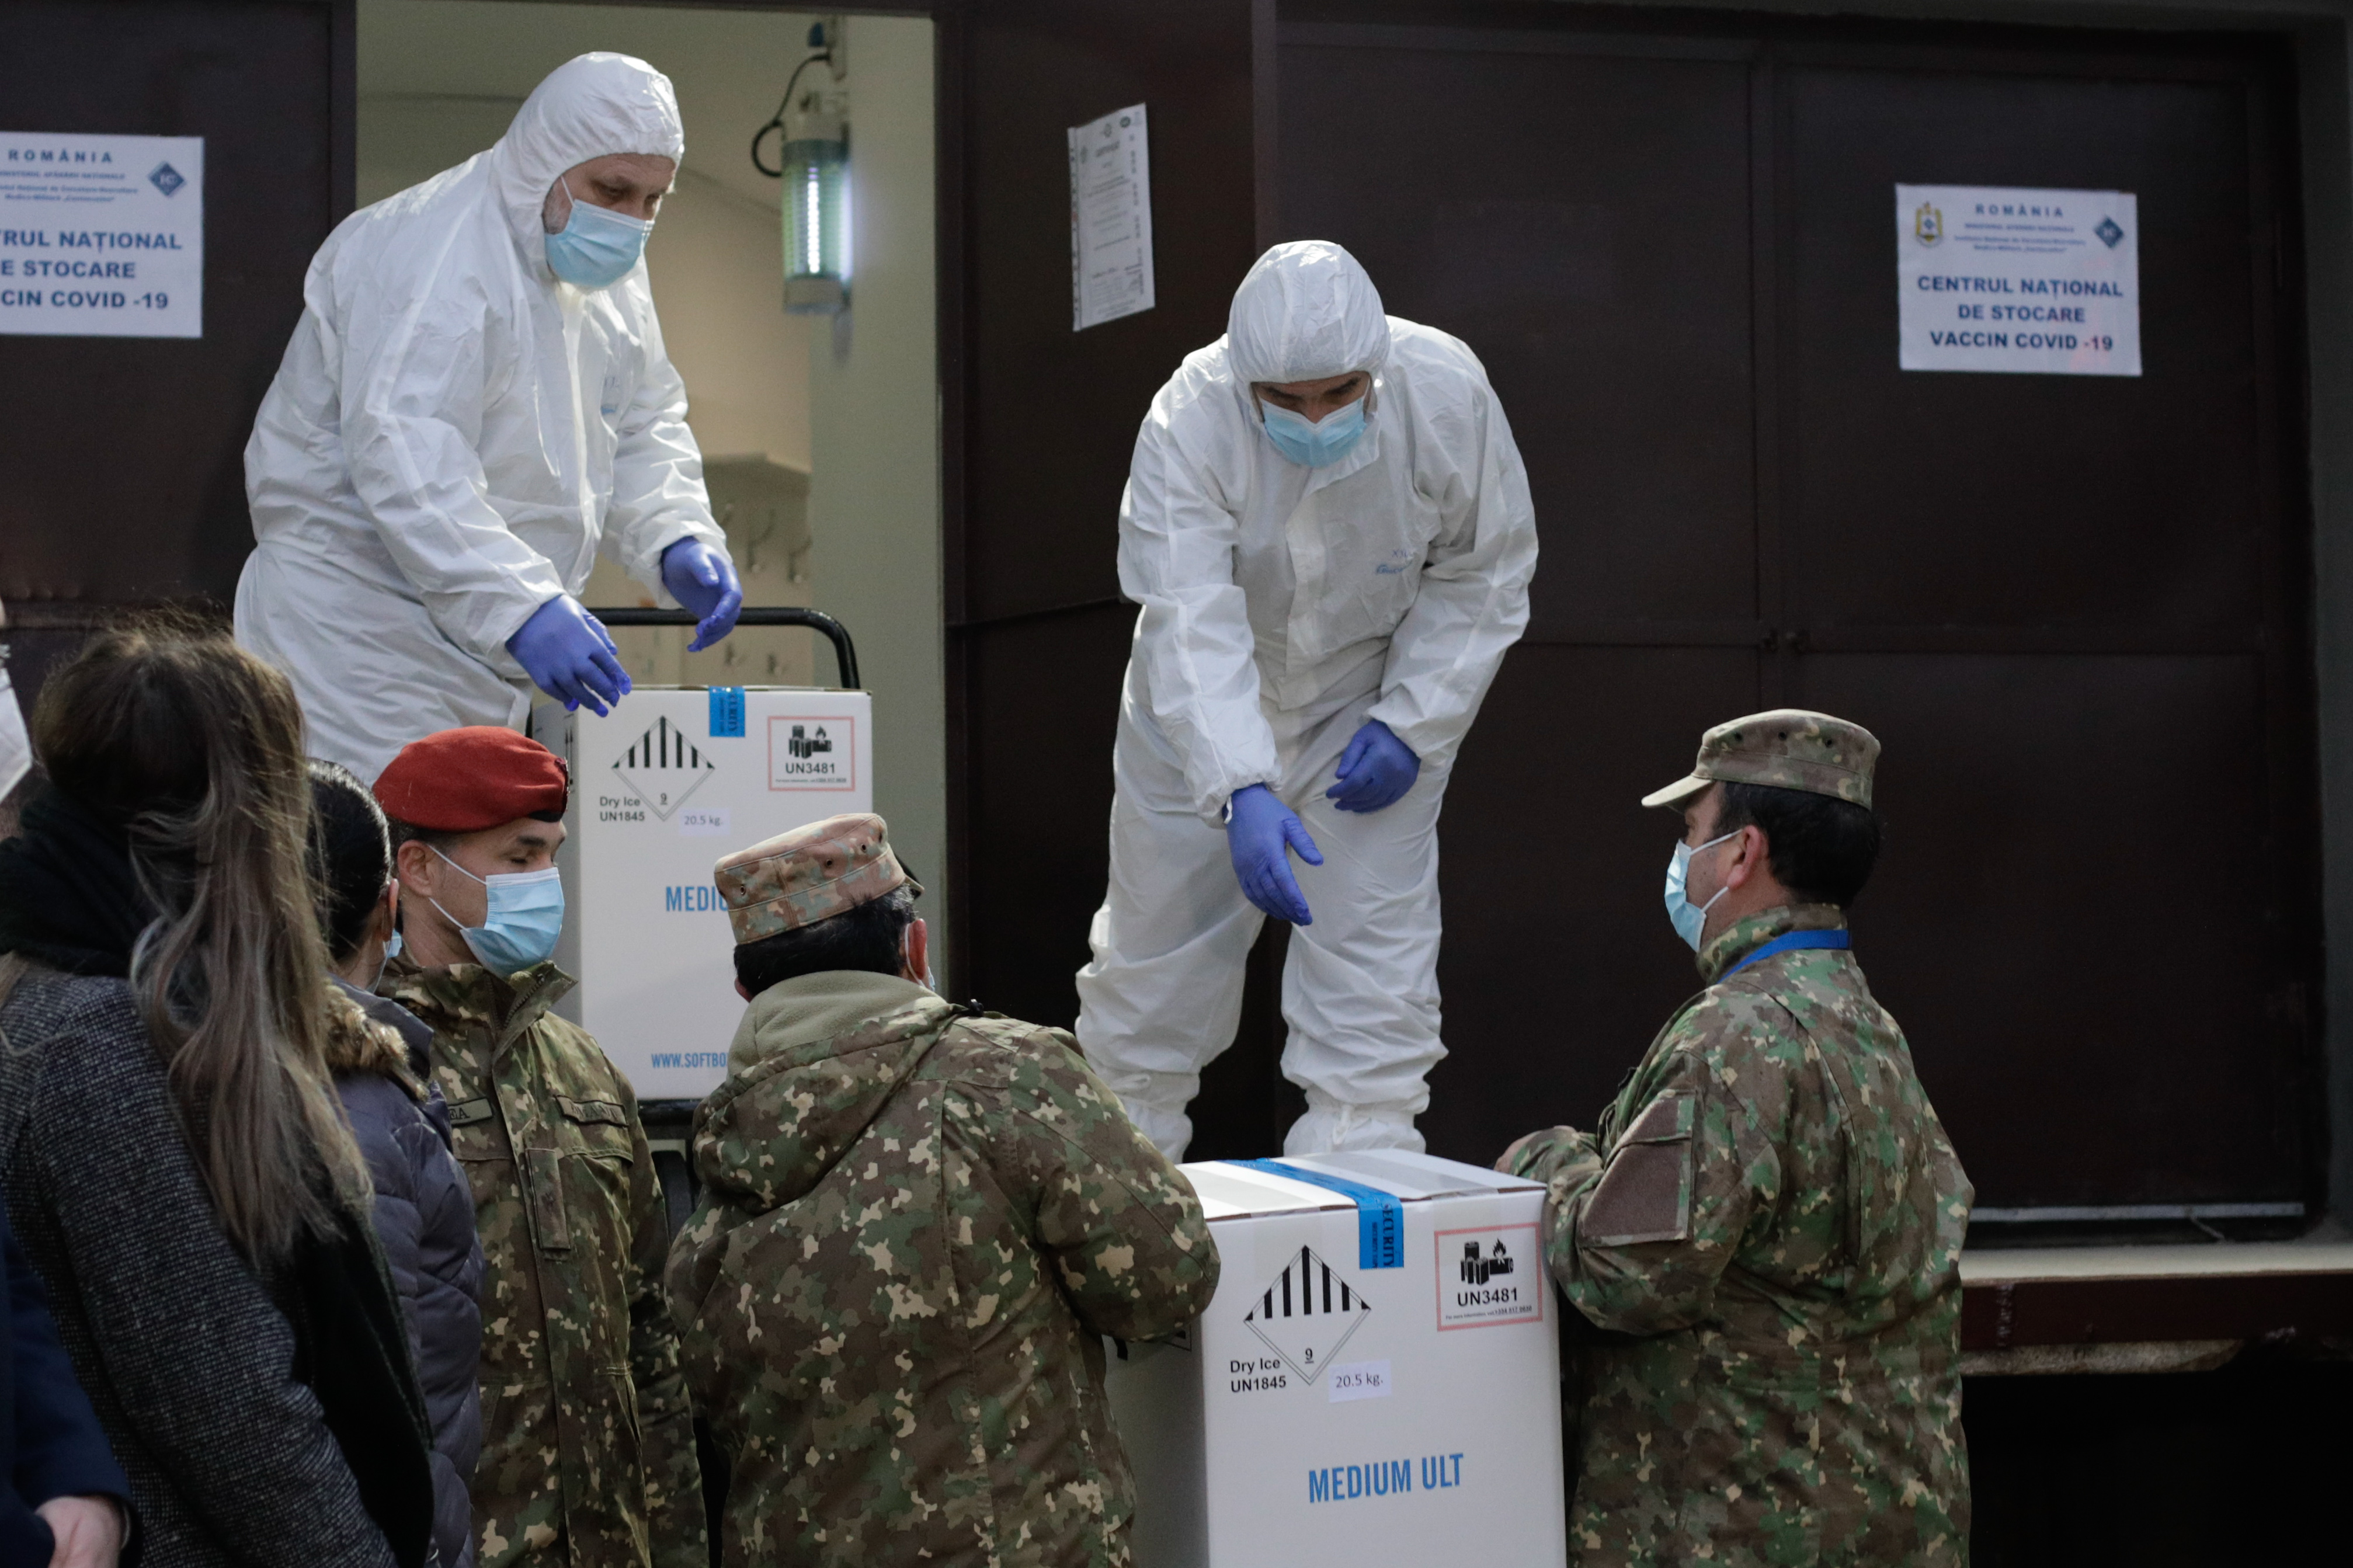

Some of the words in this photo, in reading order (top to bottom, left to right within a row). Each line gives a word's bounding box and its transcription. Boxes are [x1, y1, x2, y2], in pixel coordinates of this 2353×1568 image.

[0, 230, 50, 247] RUL
[59, 231, 182, 253] NAȚIONAL
[23, 260, 136, 279] STOCARE
[1917, 275, 2014, 293] CENTRUL
[2021, 278, 2123, 300] NAȚIONAL
[50, 290, 126, 308] COVID
[133, 291, 168, 309] -19
[1958, 304, 1984, 320] DE
[1991, 304, 2086, 323] STOCARE
[1930, 331, 2008, 348] VACCIN
[2015, 332, 2077, 350] COVID
[2084, 335, 2113, 352] -19
[785, 762, 835, 774] UN3481
[600, 797, 620, 808] Dry
[624, 797, 641, 806] Ice
[660, 792, 668, 804] 9
[600, 811, 645, 822] UN1845
[684, 815, 706, 825] 20.5
[651, 1052, 728, 1068] WWW.SOFTBO
[1457, 1287, 1518, 1307] UN3481
[1305, 1348, 1313, 1362] 9
[1231, 1360, 1254, 1375] Dry
[1260, 1358, 1281, 1370] Ice
[1231, 1375, 1287, 1393] UN1845
[1336, 1374, 1362, 1388] 20.5
[1366, 1372, 1384, 1387] kg.
[1309, 1459, 1411, 1504] MEDIUM
[1421, 1452, 1464, 1490] ULT
